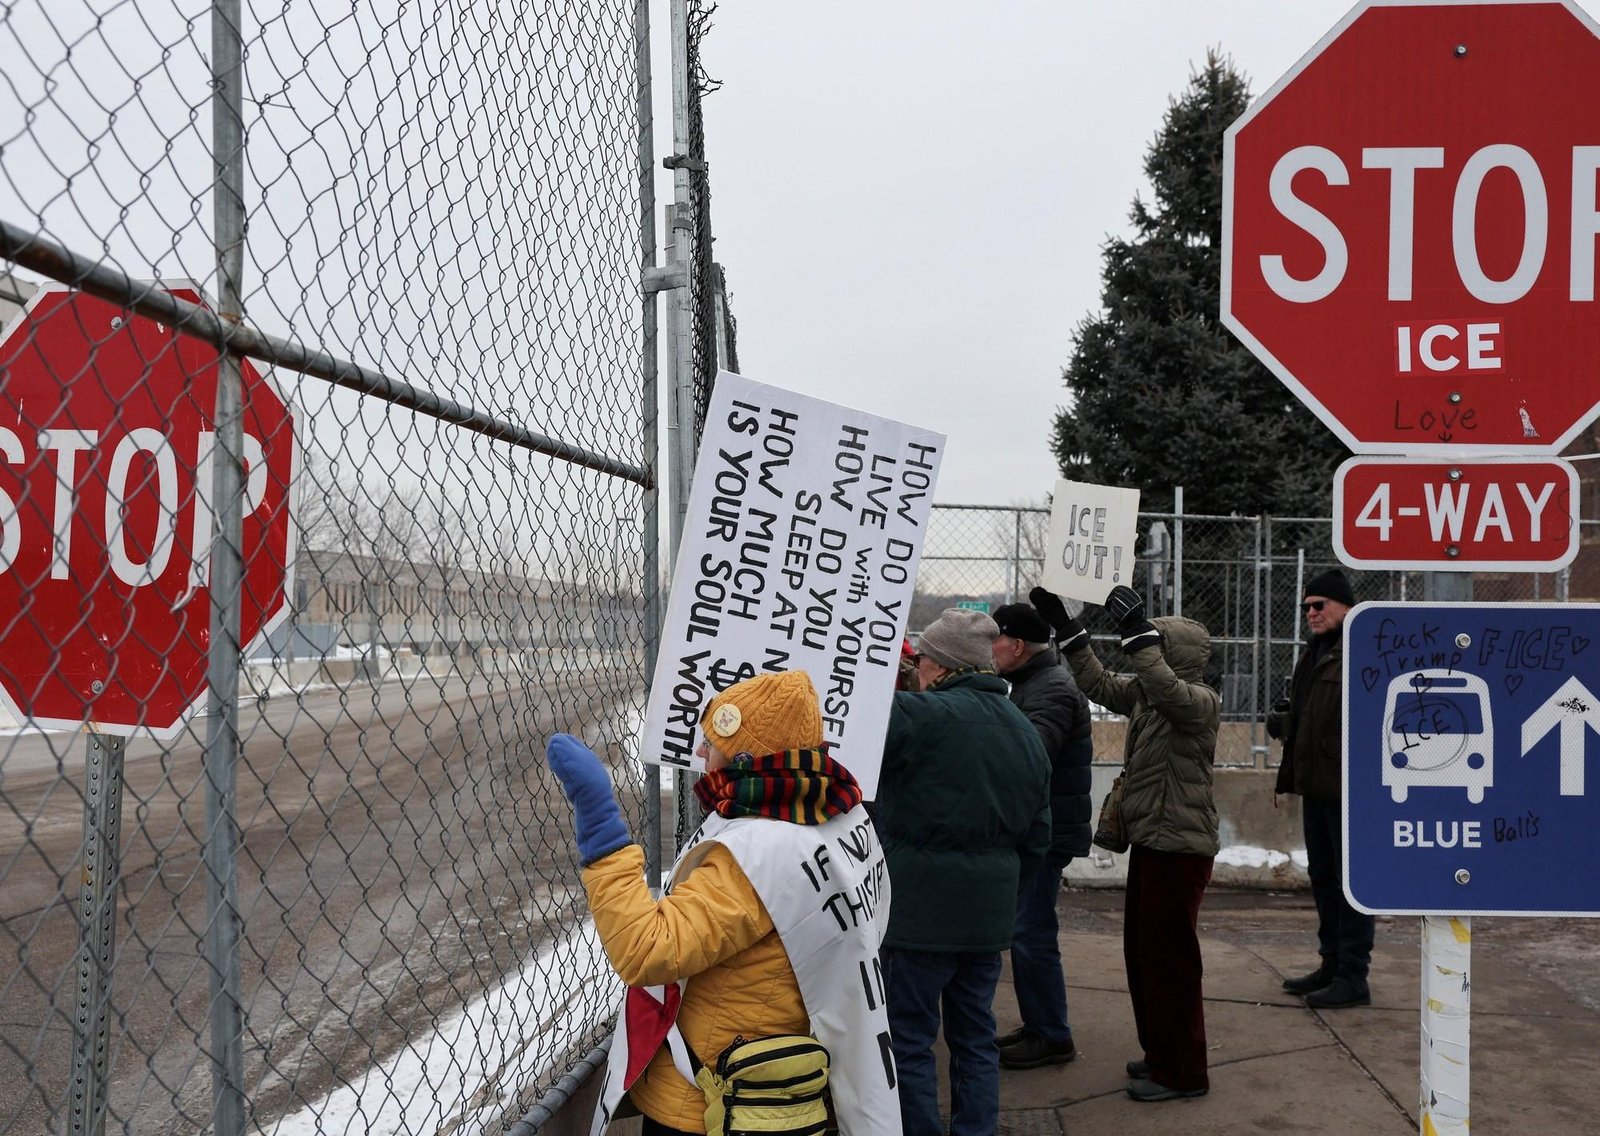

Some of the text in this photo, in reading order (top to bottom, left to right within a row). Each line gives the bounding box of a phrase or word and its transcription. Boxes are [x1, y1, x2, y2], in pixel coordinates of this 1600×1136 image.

[1397, 323, 1502, 372] ICE
[1394, 400, 1478, 431] Love
[758, 408, 799, 498] HOW
[1069, 504, 1107, 542] ICE
[1355, 483, 1557, 542] 4-WAY
[781, 490, 822, 590] SLEEP
[802, 425, 869, 650] HOW DO YOU
[866, 443, 937, 667] HOW DO YOU
[1062, 540, 1123, 583] OUT!
[660, 400, 761, 767] IS YOUR SOUL WORTH
[727, 508, 777, 620] MUCH
[770, 591, 798, 640] AT
[822, 454, 896, 749] LIVE with YOURSE
[1374, 618, 1440, 651] fuck
[1478, 626, 1571, 671] F-ICE
[1378, 650, 1462, 676] Trump
[1396, 709, 1451, 752] ICE
[1393, 821, 1482, 848] BLUE
[801, 844, 830, 892] IF
